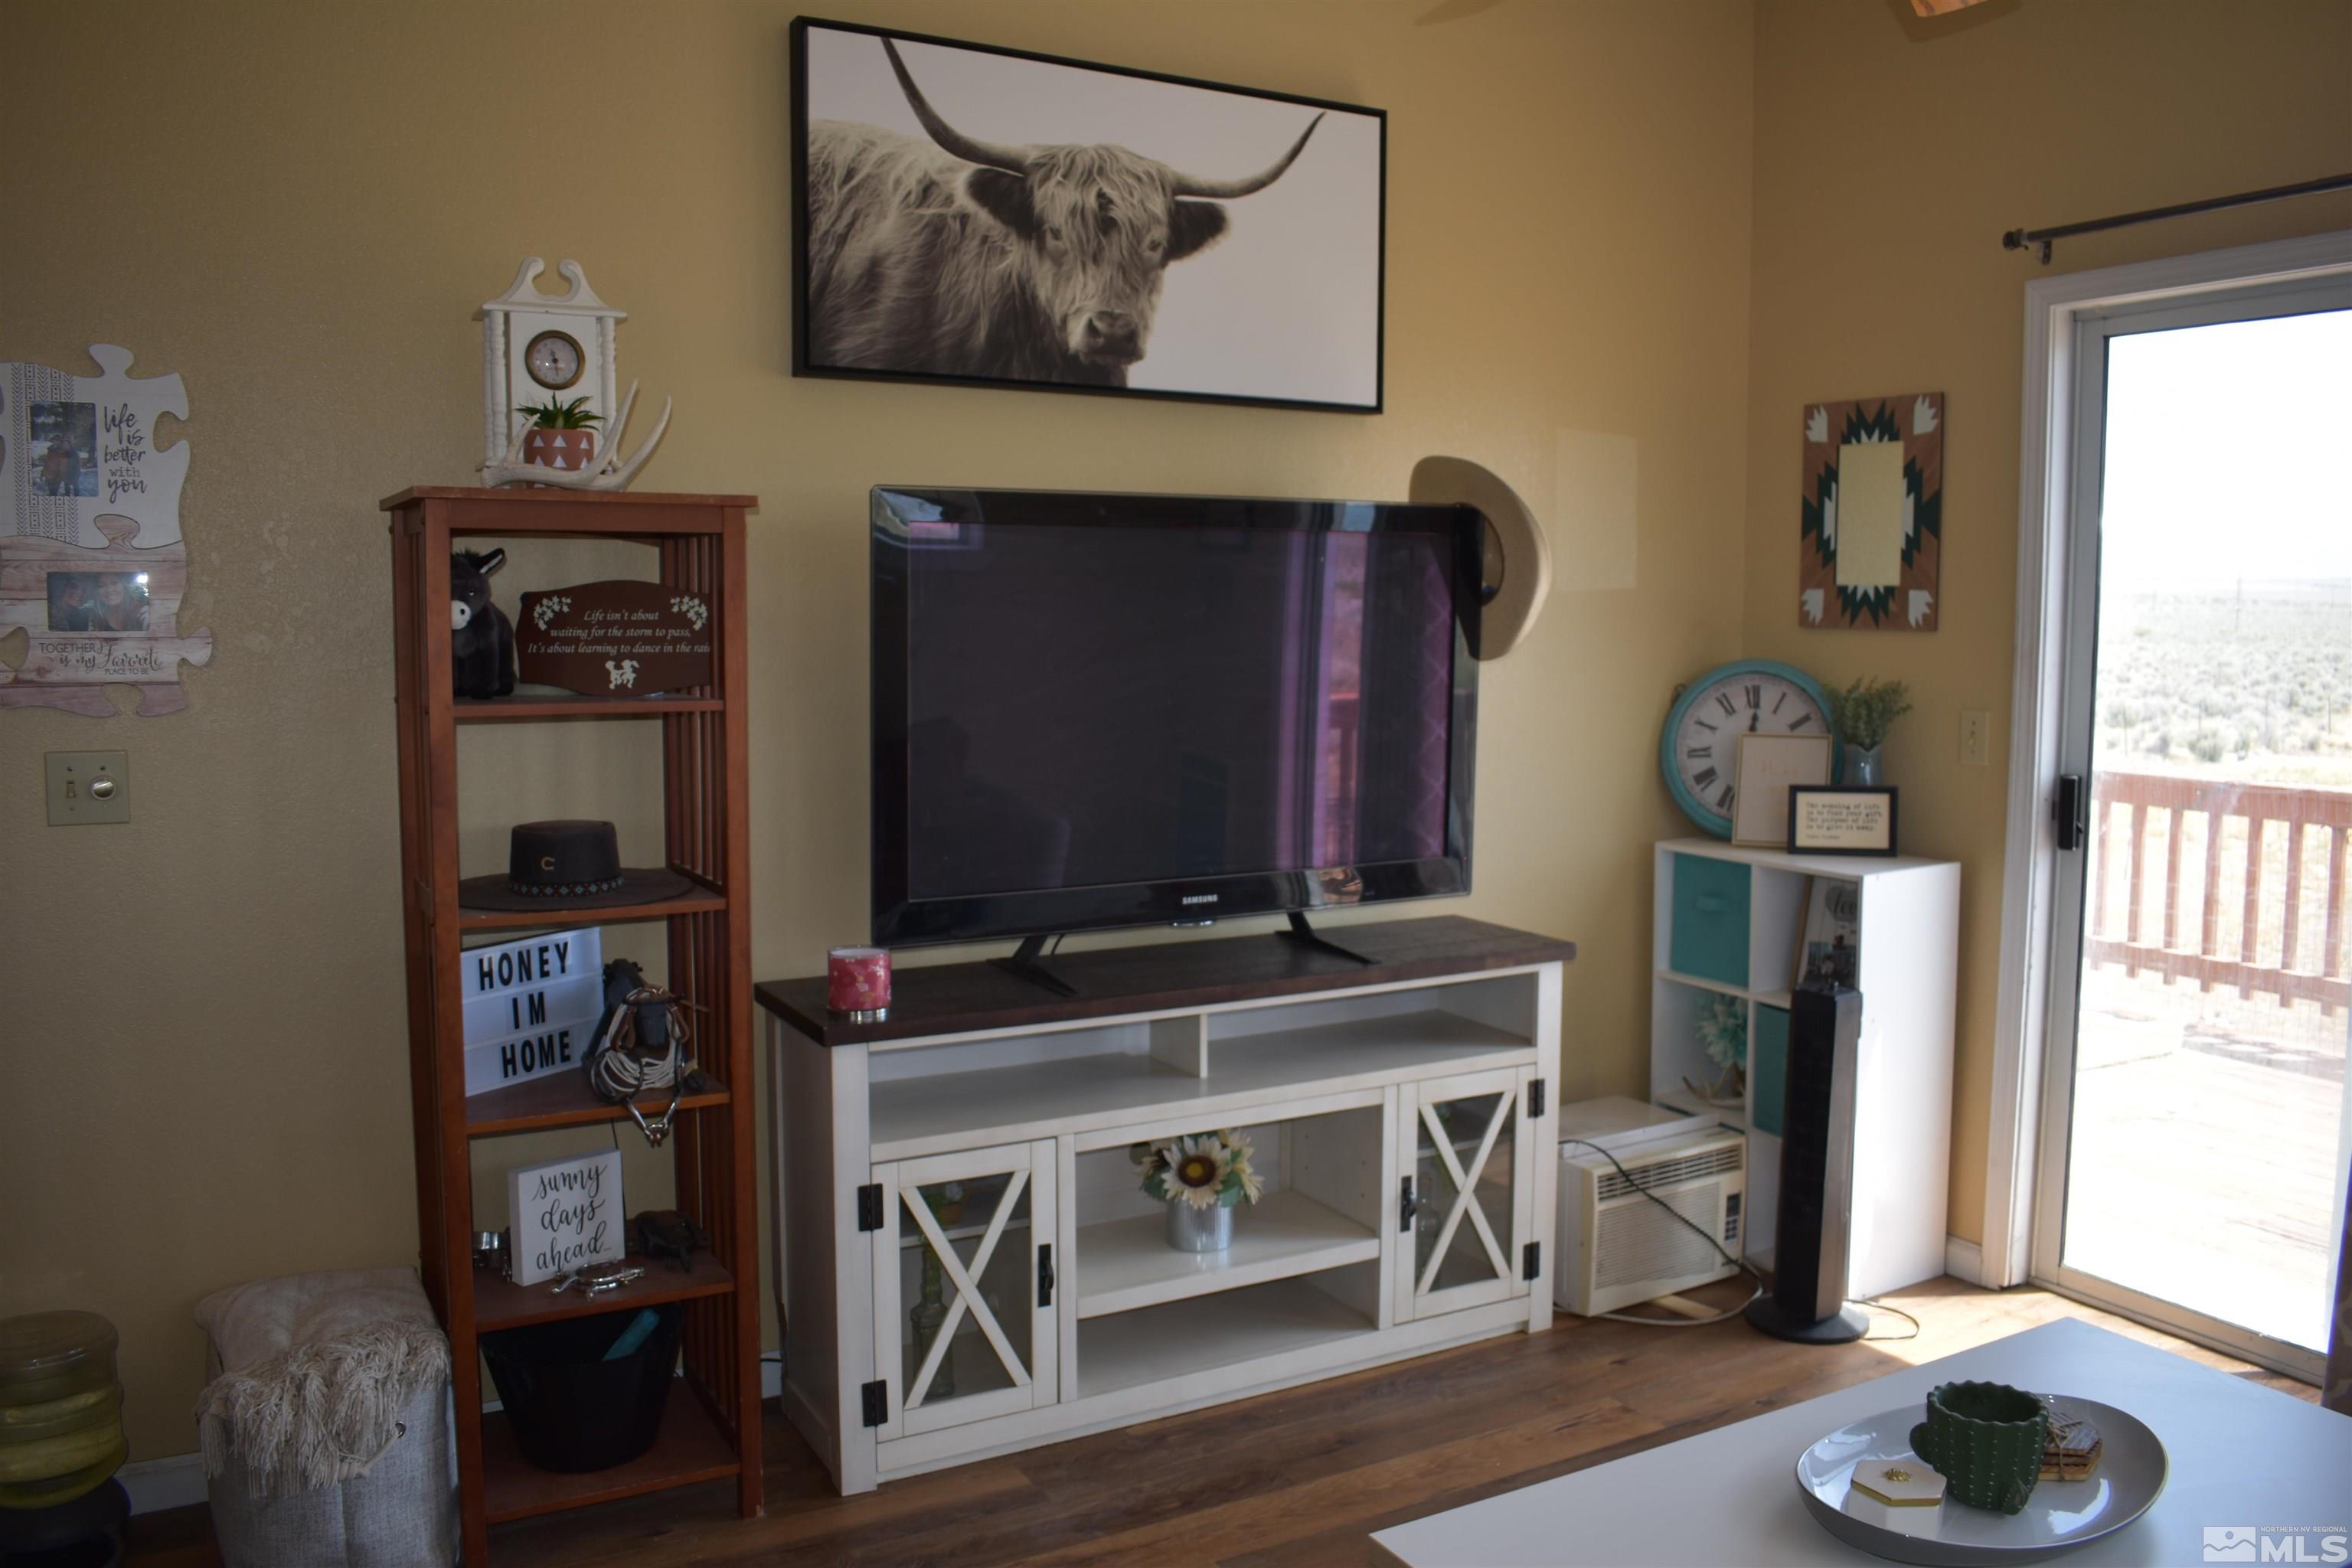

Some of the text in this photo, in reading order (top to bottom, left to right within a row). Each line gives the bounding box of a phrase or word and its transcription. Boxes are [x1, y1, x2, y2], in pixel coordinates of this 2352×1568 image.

[126, 429, 145, 446] is
[104, 444, 146, 466] better
[109, 466, 141, 477] with
[108, 479, 148, 504] you
[583, 609, 659, 623] Life isn't about
[551, 626, 691, 640] waiting for the storm to pass,
[38, 642, 96, 653] TOGETHER
[528, 643, 545, 653] It's
[547, 642, 575, 653] about
[578, 642, 618, 656] learning
[632, 642, 661, 652] dance
[663, 643, 673, 652] in
[676, 642, 691, 652] the
[60, 654, 71, 668] is
[76, 655, 96, 675] my
[1182, 894, 1218, 905] SAMSUNG
[479, 941, 569, 991] HONEY
[512, 991, 546, 1030] IM
[501, 1030, 571, 1078] HOME
[531, 1164, 608, 1201] sunny
[541, 1198, 606, 1235] days
